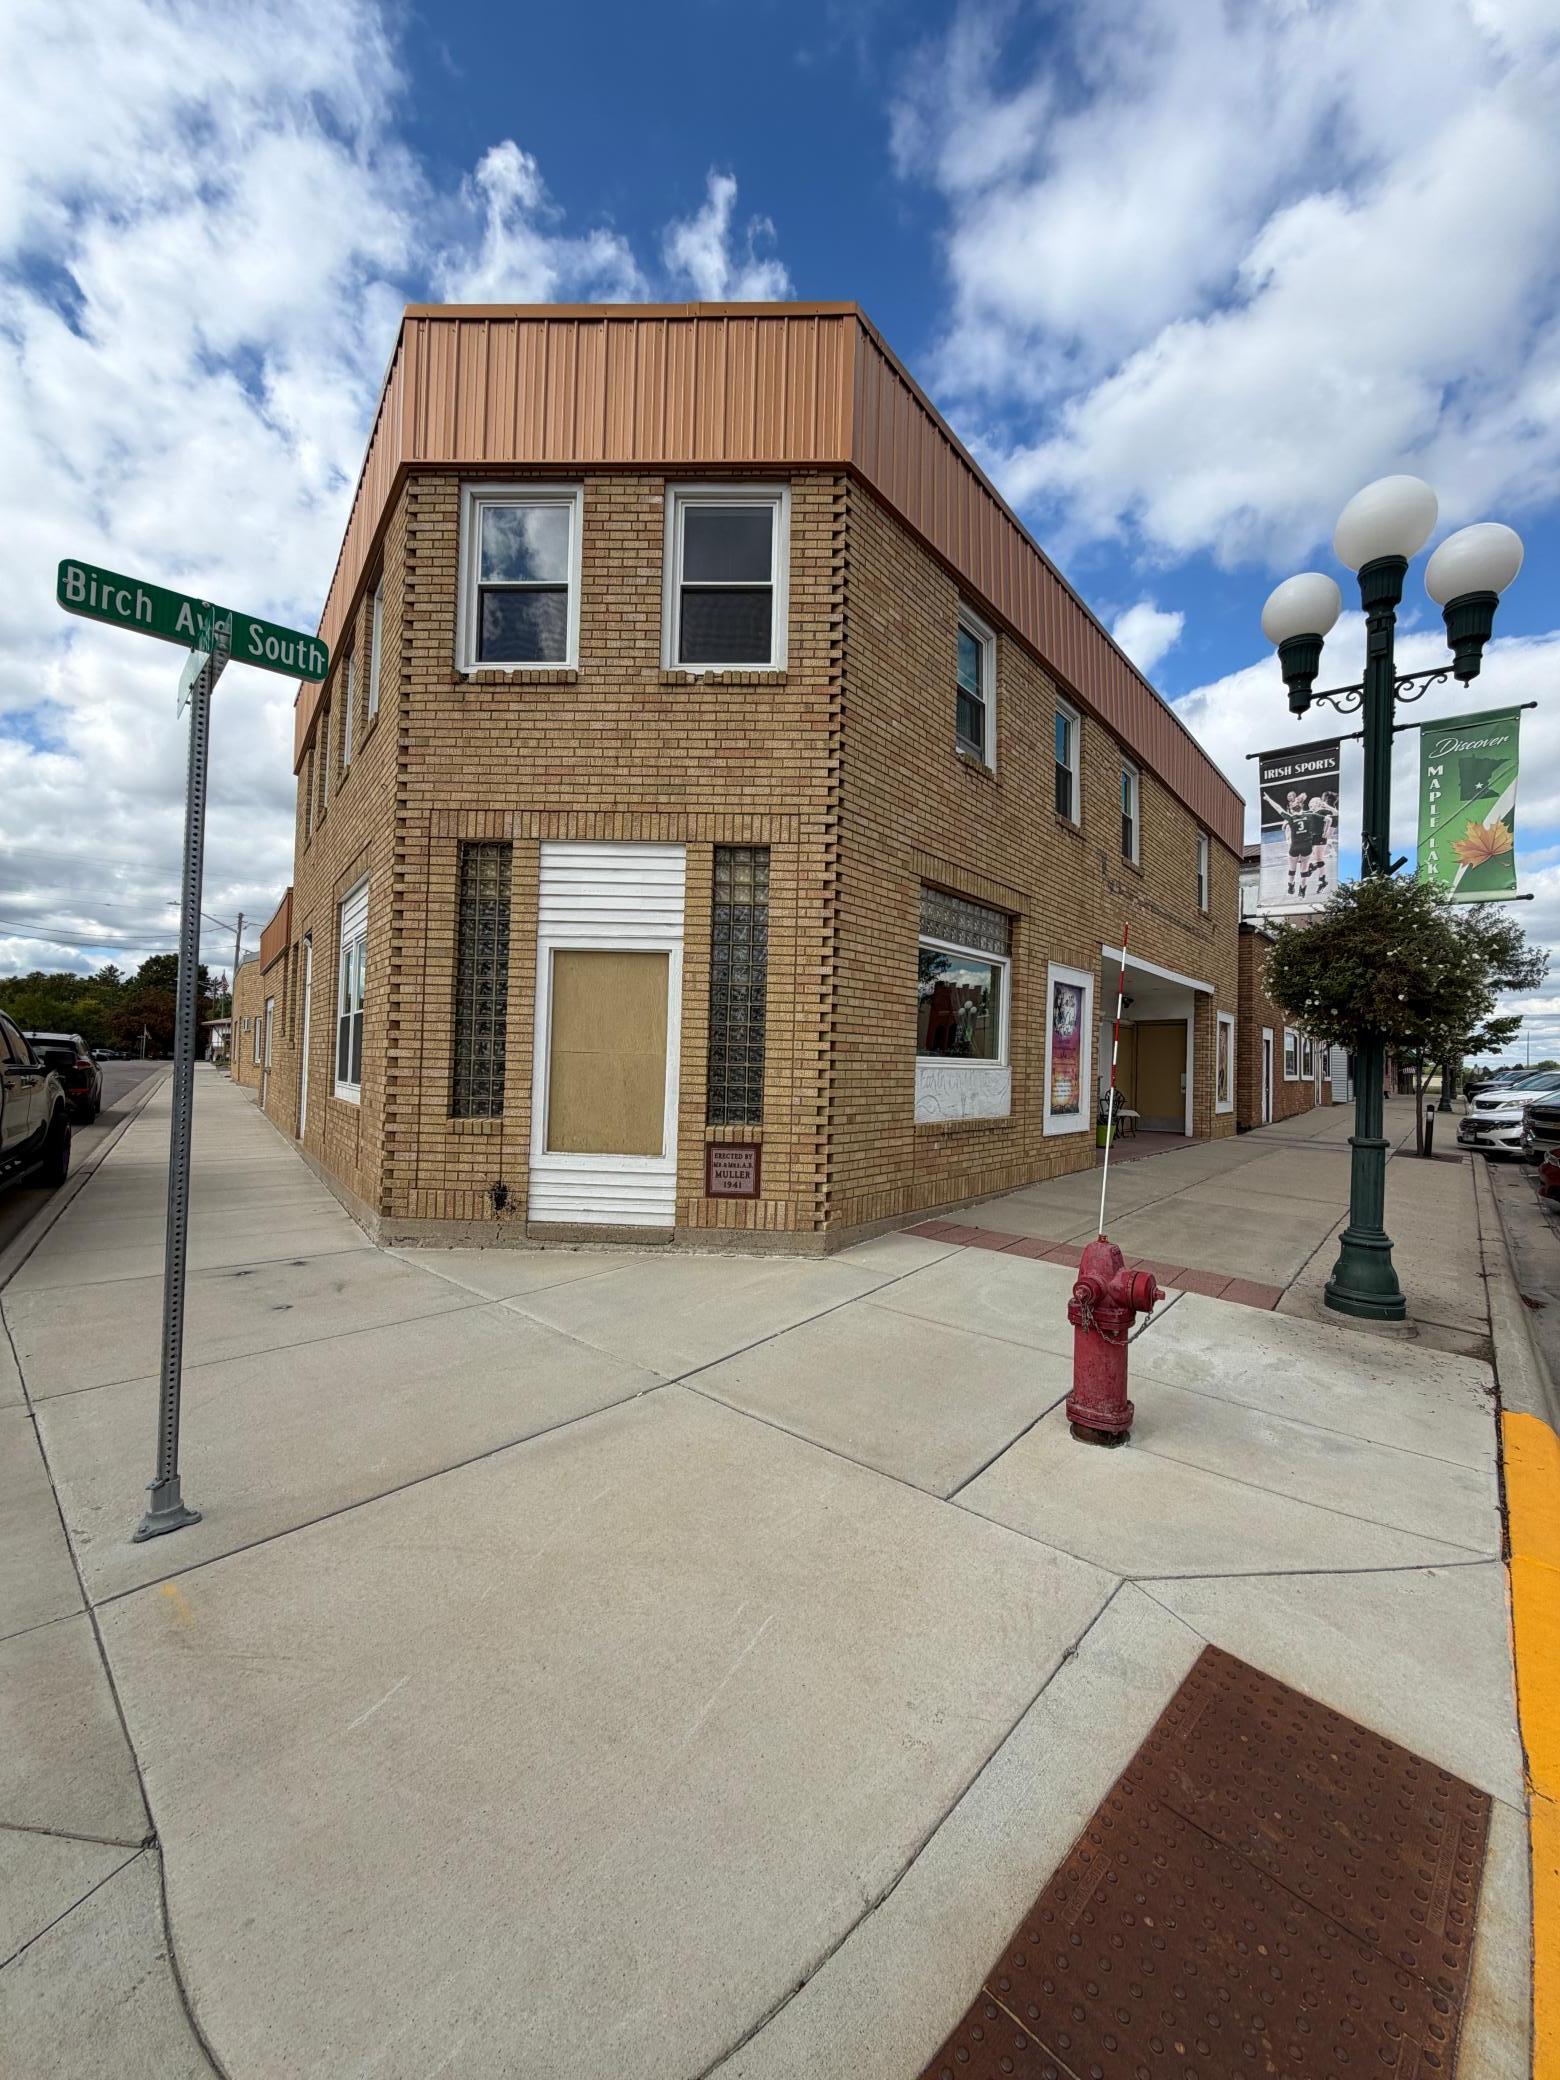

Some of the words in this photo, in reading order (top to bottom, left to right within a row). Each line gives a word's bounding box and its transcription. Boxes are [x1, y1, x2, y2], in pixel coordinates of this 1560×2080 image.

[65, 565, 153, 623] Birch
[248, 623, 323, 674] South
[1428, 735, 1510, 759] Discover
[1264, 765, 1292, 780] IRISH
[1294, 757, 1336, 774] SPORTS
[1427, 764, 1444, 828] MAPLE
[1297, 821, 1305, 831] 3
[1427, 838, 1440, 882] LAK
[715, 1170, 750, 1179] MULLER
[723, 1181, 742, 1189] 1941
